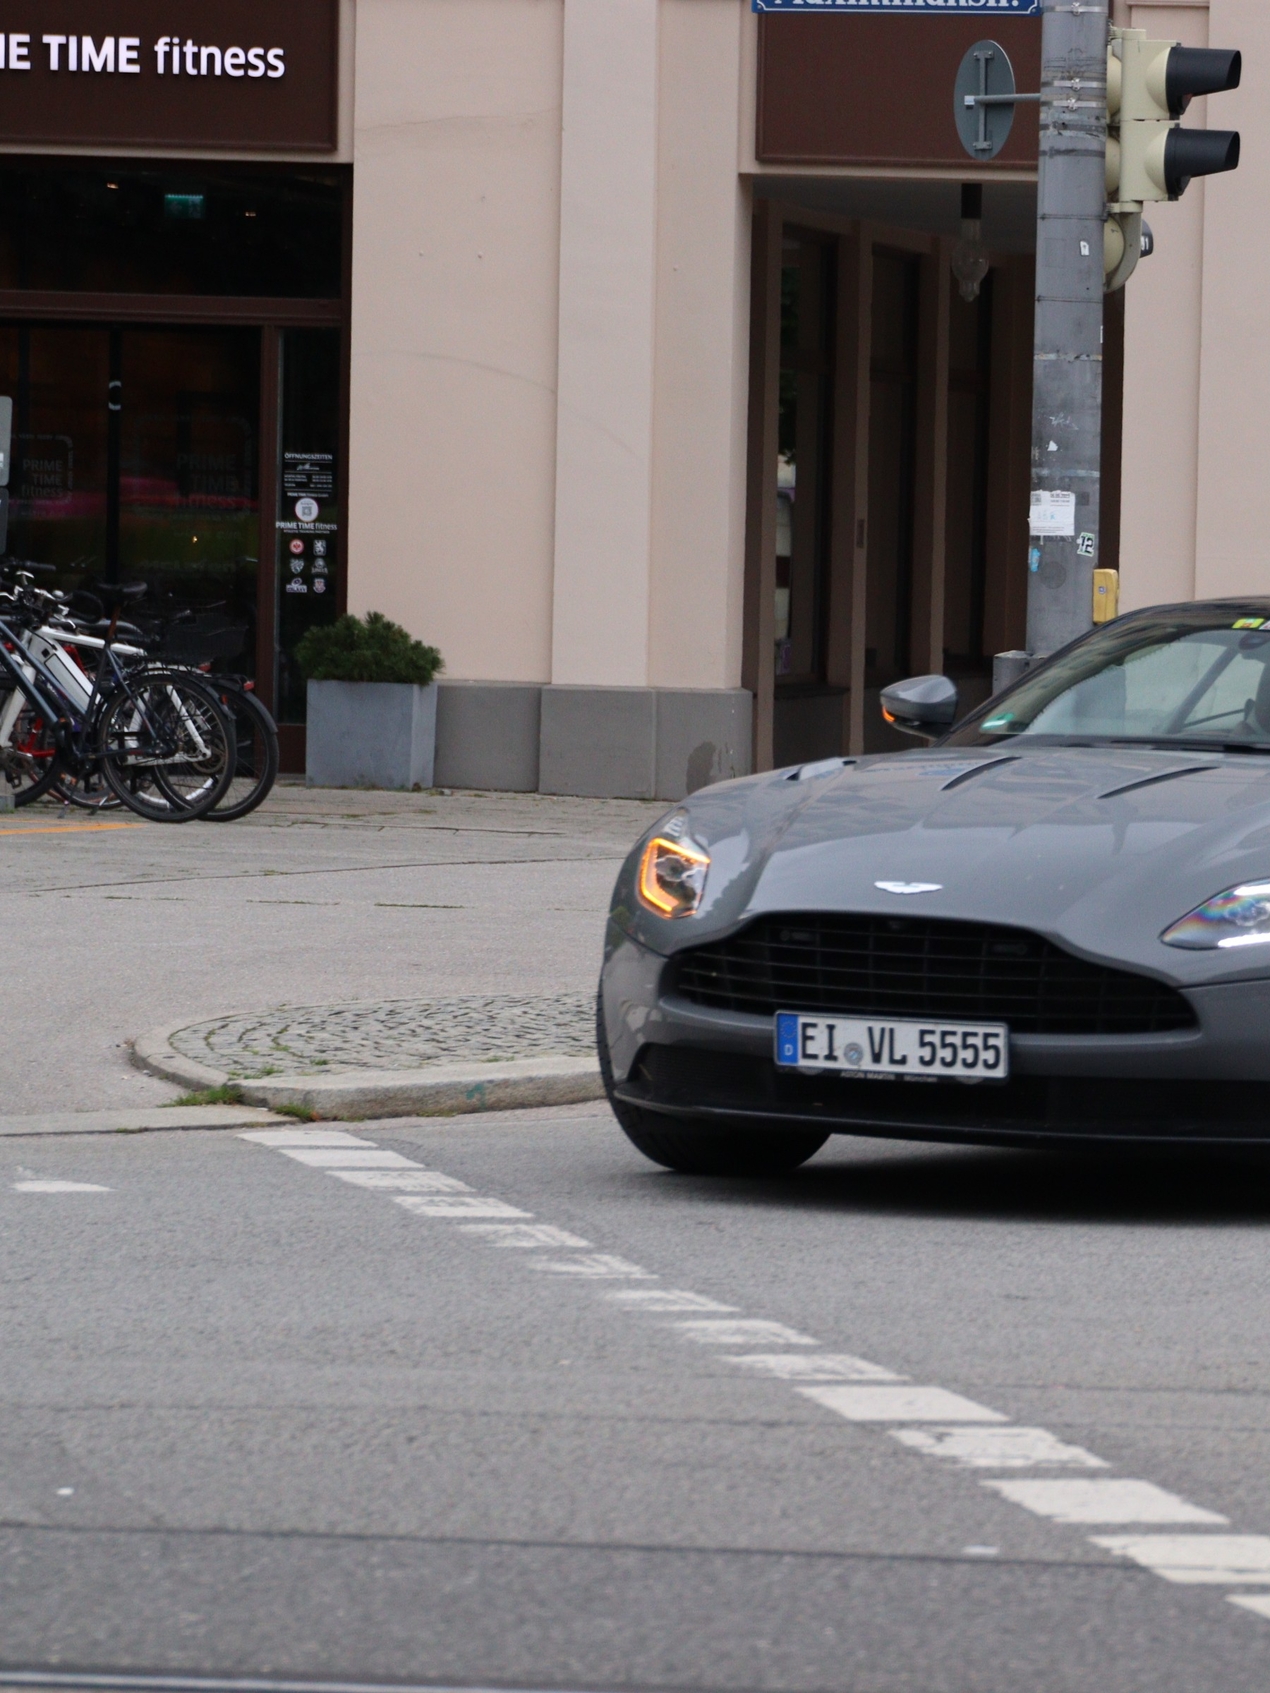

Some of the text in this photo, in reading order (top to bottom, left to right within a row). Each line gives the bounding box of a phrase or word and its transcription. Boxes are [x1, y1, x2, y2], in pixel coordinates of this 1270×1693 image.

[42, 34, 140, 74] TIME
[154, 36, 286, 78] fitness
[275, 520, 338, 531] PRIME TIME fitness
[784, 1022, 1001, 1070] D EI VL 5555
